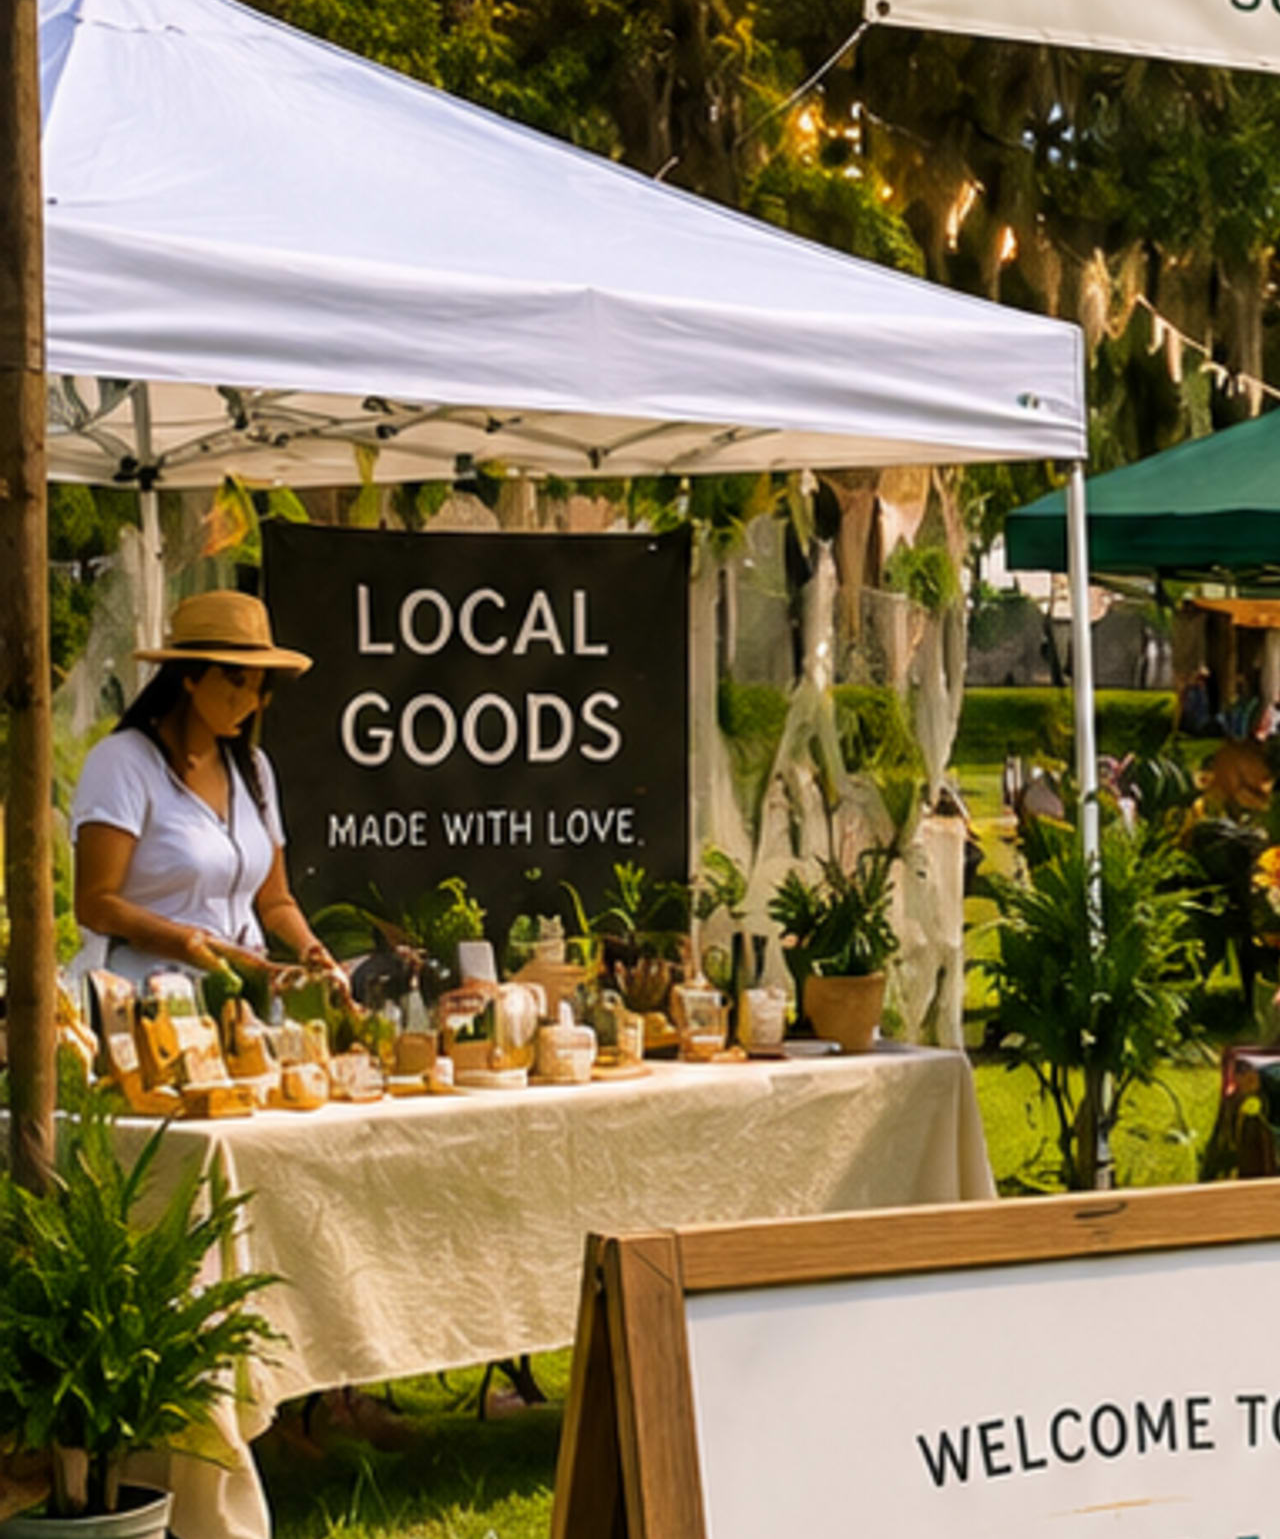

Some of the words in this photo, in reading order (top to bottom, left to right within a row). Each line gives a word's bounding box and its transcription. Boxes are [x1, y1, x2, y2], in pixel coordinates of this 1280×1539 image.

[359, 585, 608, 655] LOCAL
[342, 693, 620, 764] GOODS
[329, 812, 426, 846] MADE
[443, 811, 531, 844] WITH
[918, 1398, 1214, 1486] WELCOME
